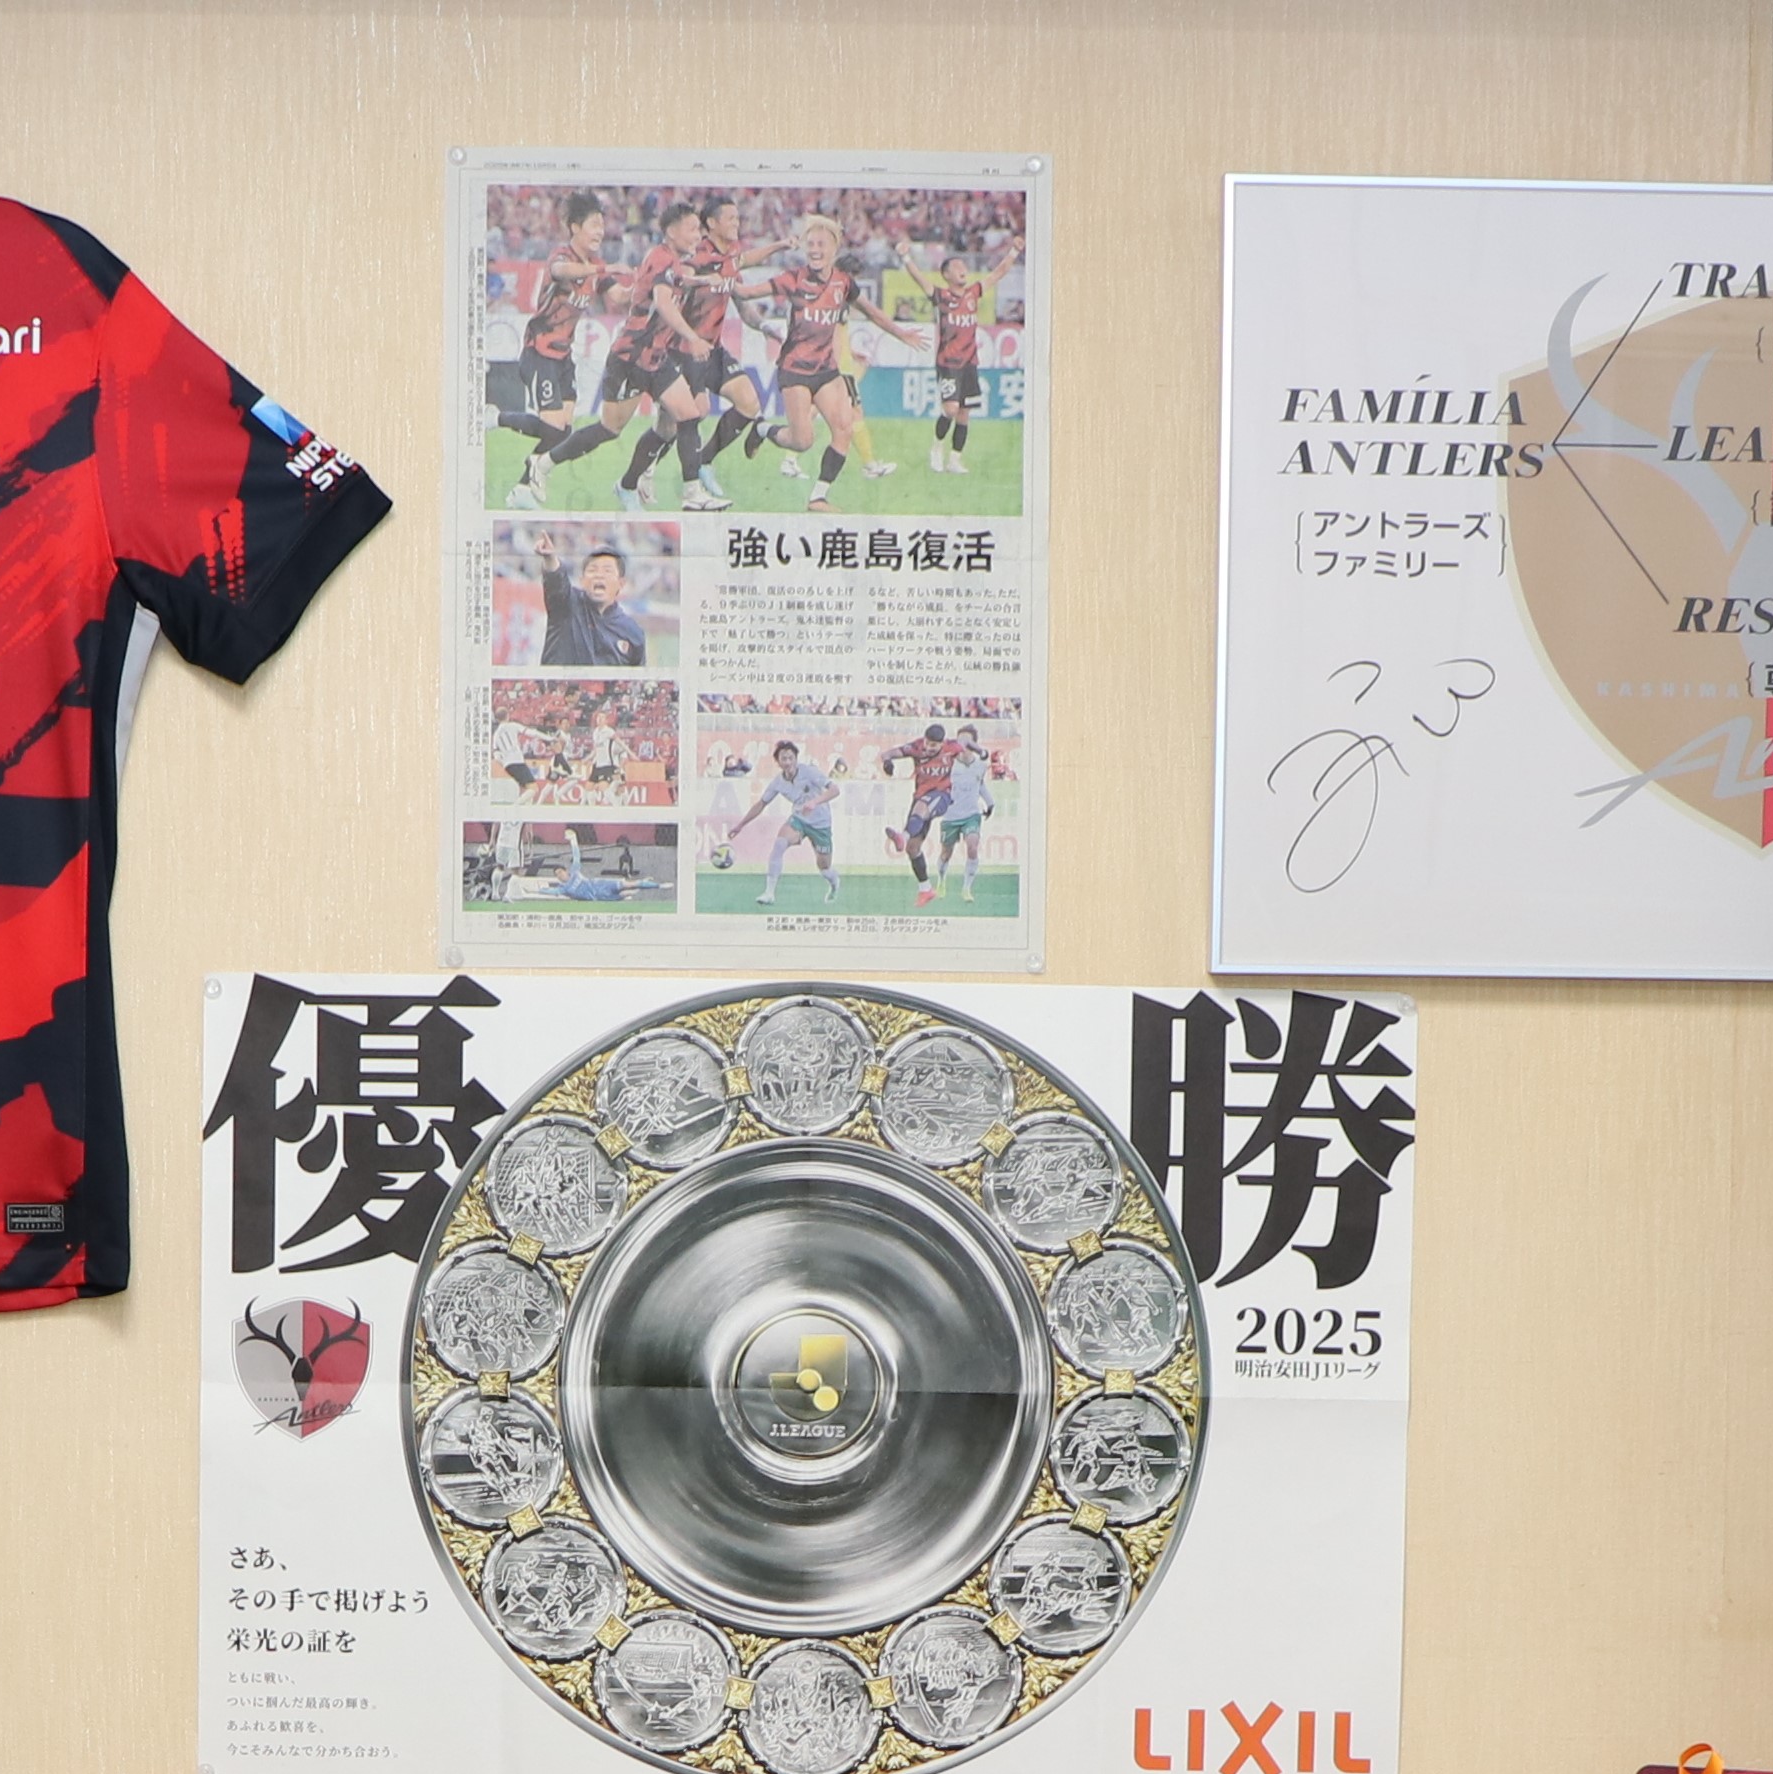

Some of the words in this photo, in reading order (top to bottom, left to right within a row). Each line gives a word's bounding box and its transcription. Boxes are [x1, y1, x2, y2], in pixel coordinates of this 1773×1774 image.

[1279, 374, 1528, 430] FAMÍLIA
[1277, 440, 1547, 482] ANTLERS
[728, 527, 995, 573] 強い鹿島復活
[204, 978, 498, 1280] 優
[1131, 990, 1418, 1290] 勝
[1234, 1307, 1383, 1357] 2025
[1234, 1358, 1382, 1381] 明治安田J1リーグ
[769, 1423, 846, 1438] J.LEAGUE
[229, 1546, 288, 1571] さあ、
[228, 1587, 430, 1614] その手で掲げよう
[227, 1627, 357, 1654] 栄光の証を
[227, 1671, 297, 1685] ともに戦い、
[226, 1719, 326, 1734] あふれる歓喜を、
[227, 1743, 399, 1759] 今こそみんなで分かち合おう。
